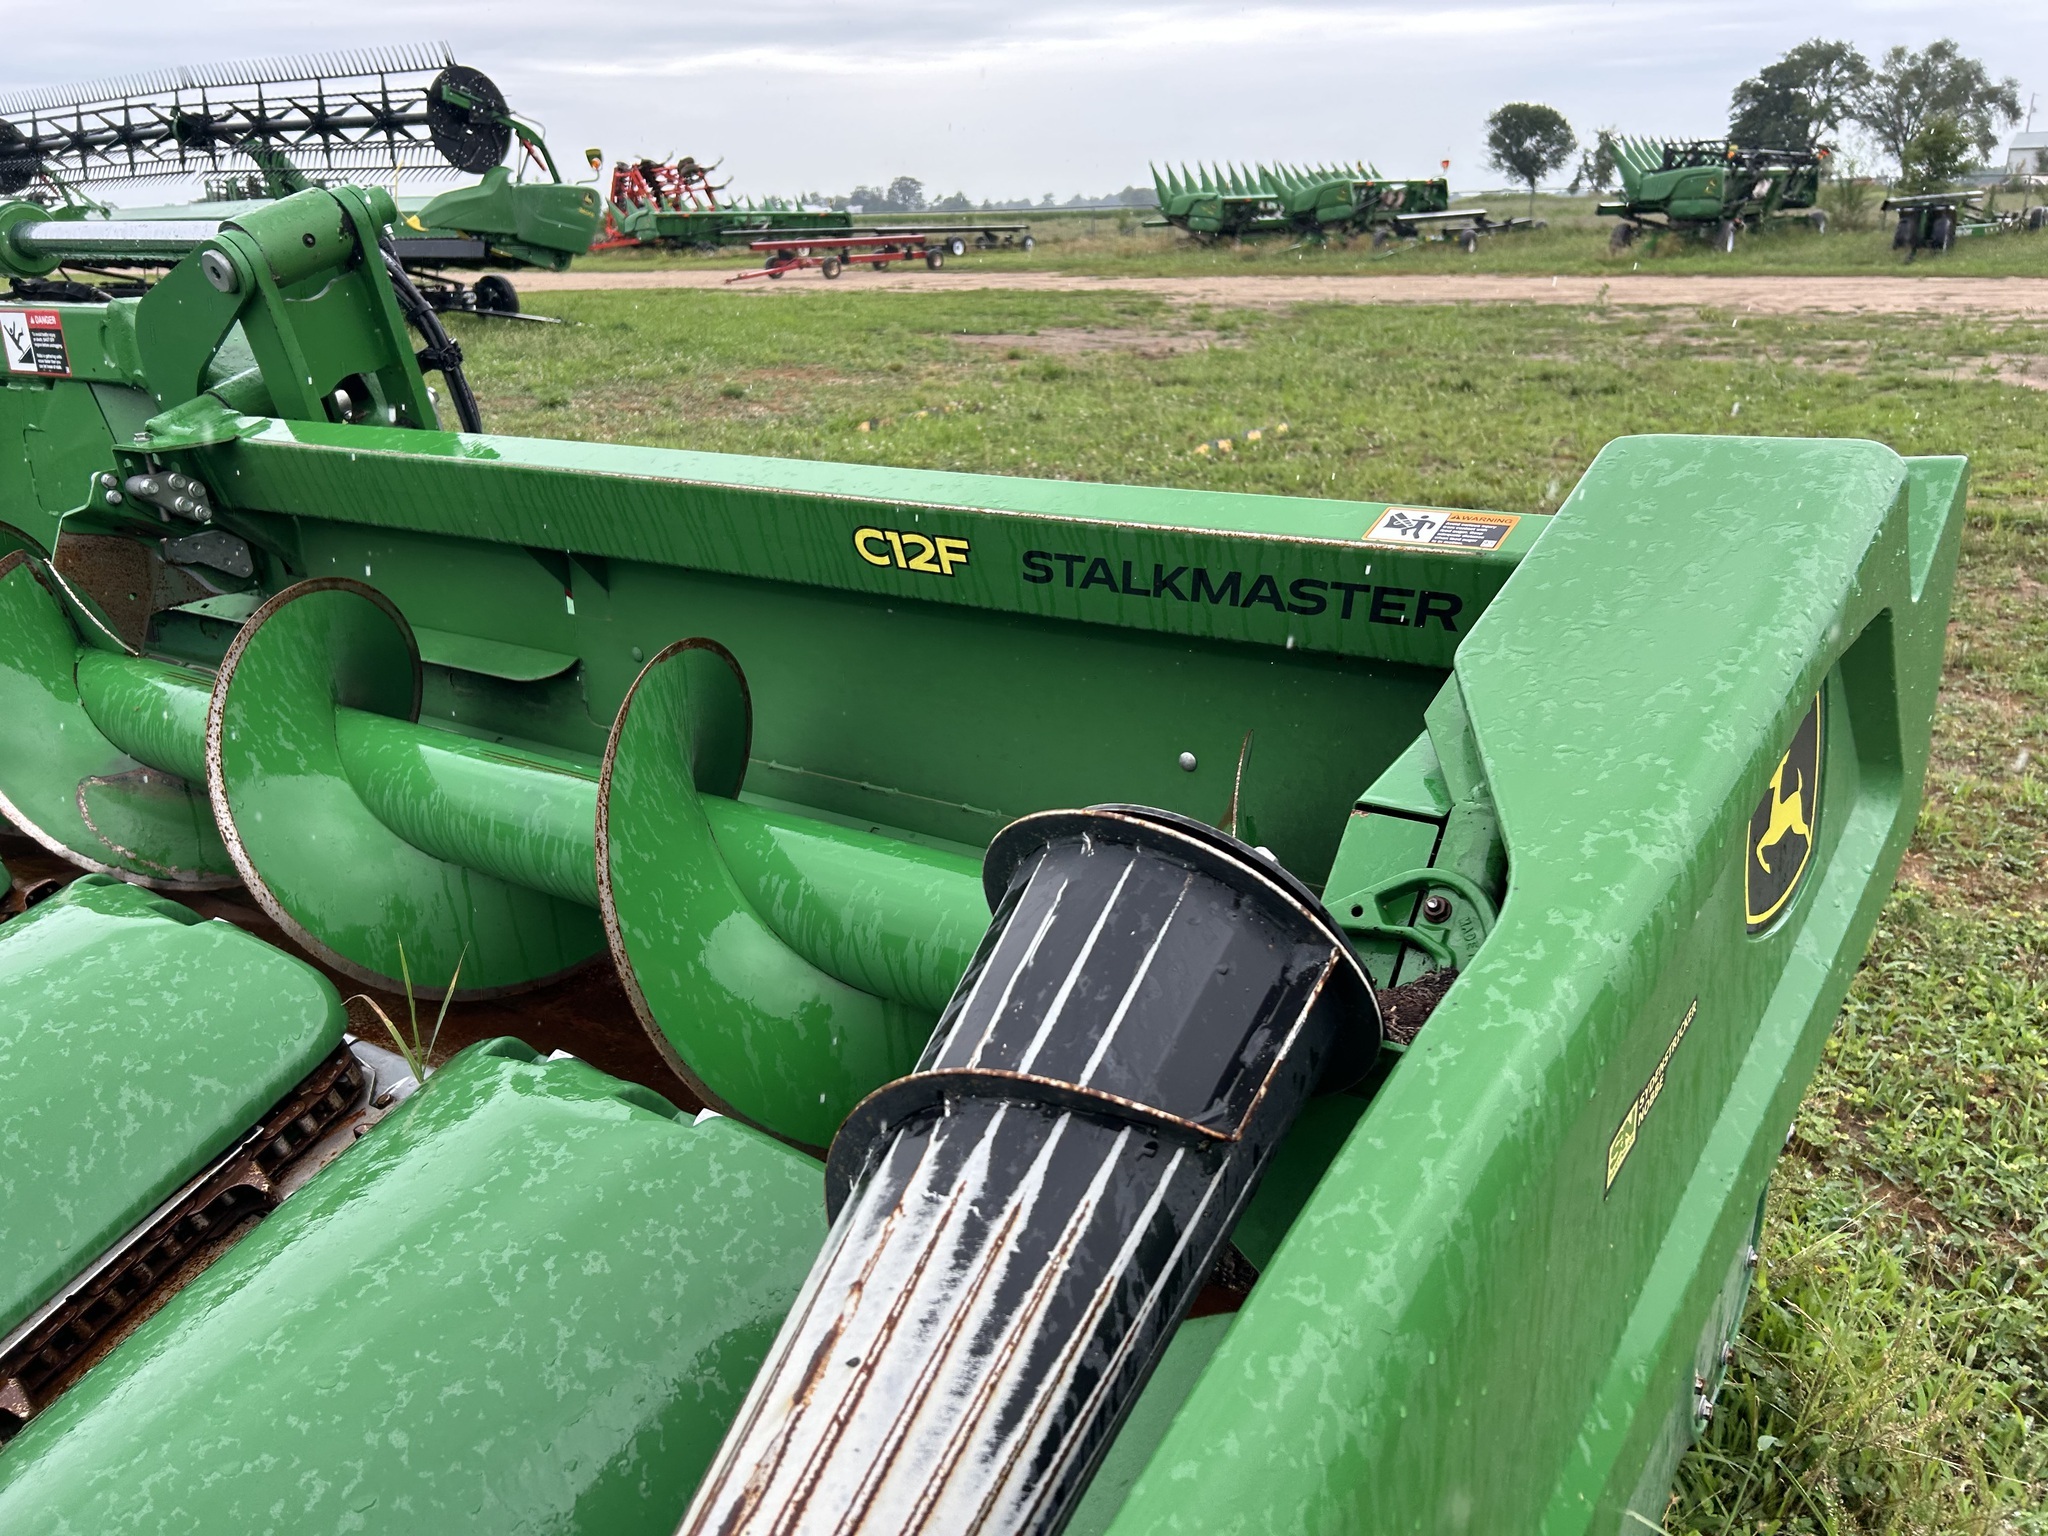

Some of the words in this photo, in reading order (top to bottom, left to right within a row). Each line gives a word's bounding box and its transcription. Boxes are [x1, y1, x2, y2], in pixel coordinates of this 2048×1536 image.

[34, 315, 56, 324] DANGER
[1462, 515, 1513, 523] WARNING
[852, 525, 971, 577] C12F
[1021, 550, 1464, 633] STALKMASTER
[1459, 917, 1480, 950] MADE
[1638, 1000, 1698, 1109] SYDENSTRICKER
[1638, 1072, 1666, 1127] NOBBE
